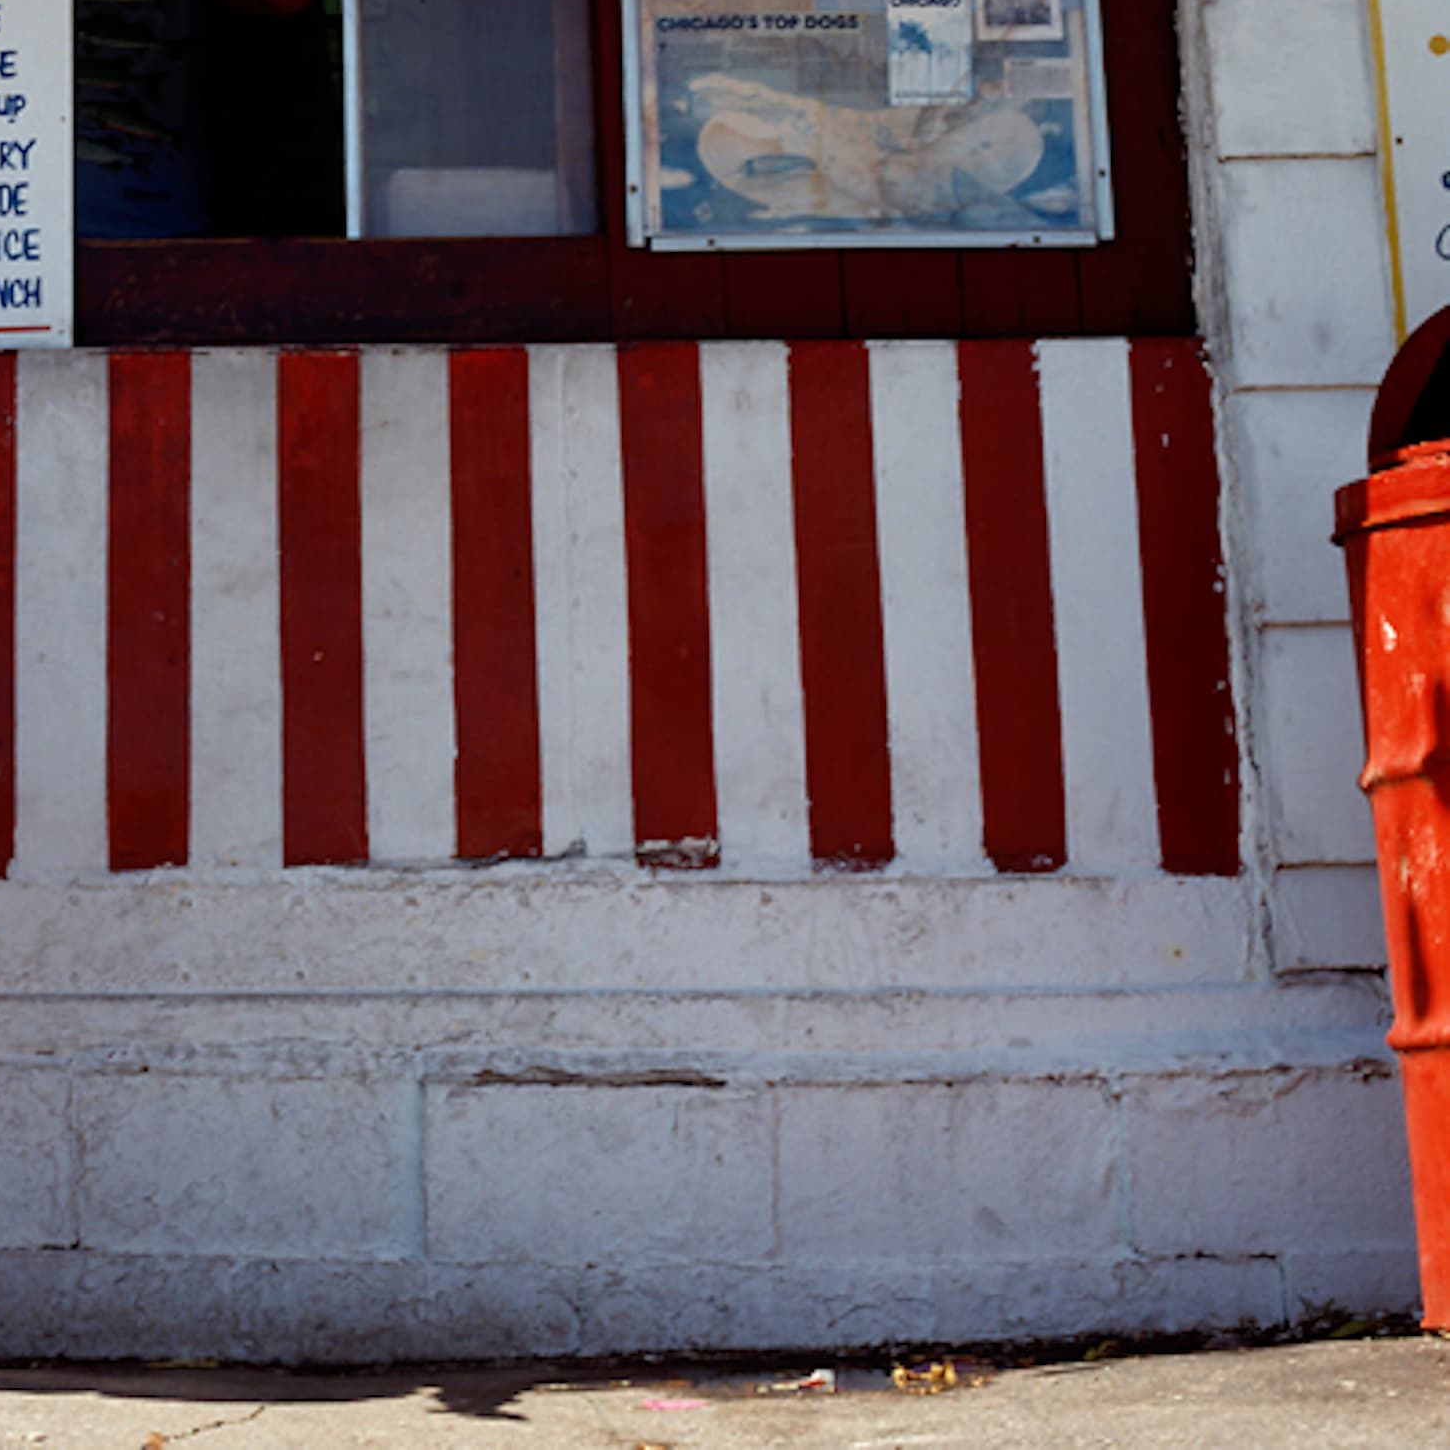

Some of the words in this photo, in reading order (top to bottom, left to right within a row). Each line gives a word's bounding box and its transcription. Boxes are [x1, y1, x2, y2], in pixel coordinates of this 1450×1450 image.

[656, 14, 758, 32] CHICAGO'S
[762, 14, 799, 29] TOP
[804, 14, 860, 30] DOGS
